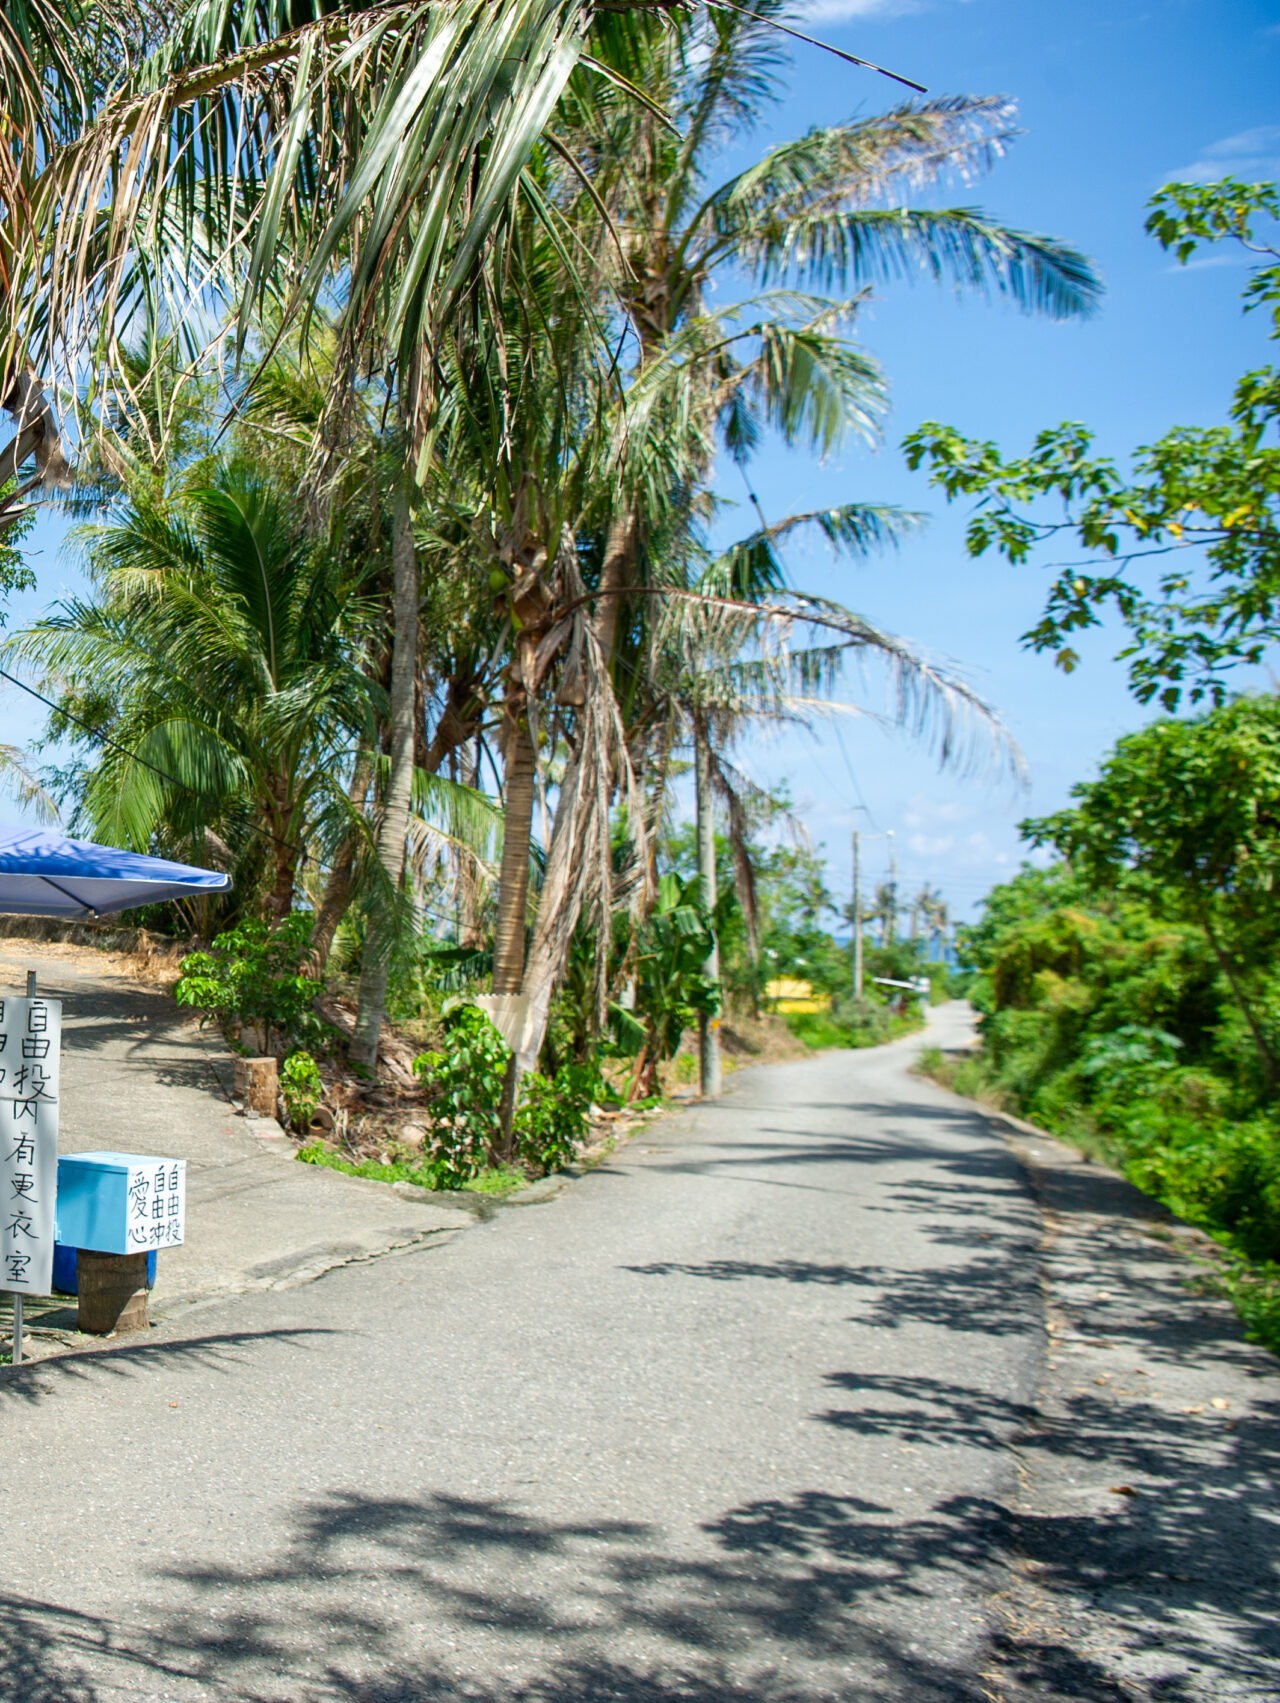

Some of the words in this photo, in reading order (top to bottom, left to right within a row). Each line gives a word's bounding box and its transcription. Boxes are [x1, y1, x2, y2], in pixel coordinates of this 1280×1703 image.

[12, 1001, 56, 1100] 自由投
[128, 1171, 150, 1244] 愛心
[166, 1163, 182, 1243] 自由投
